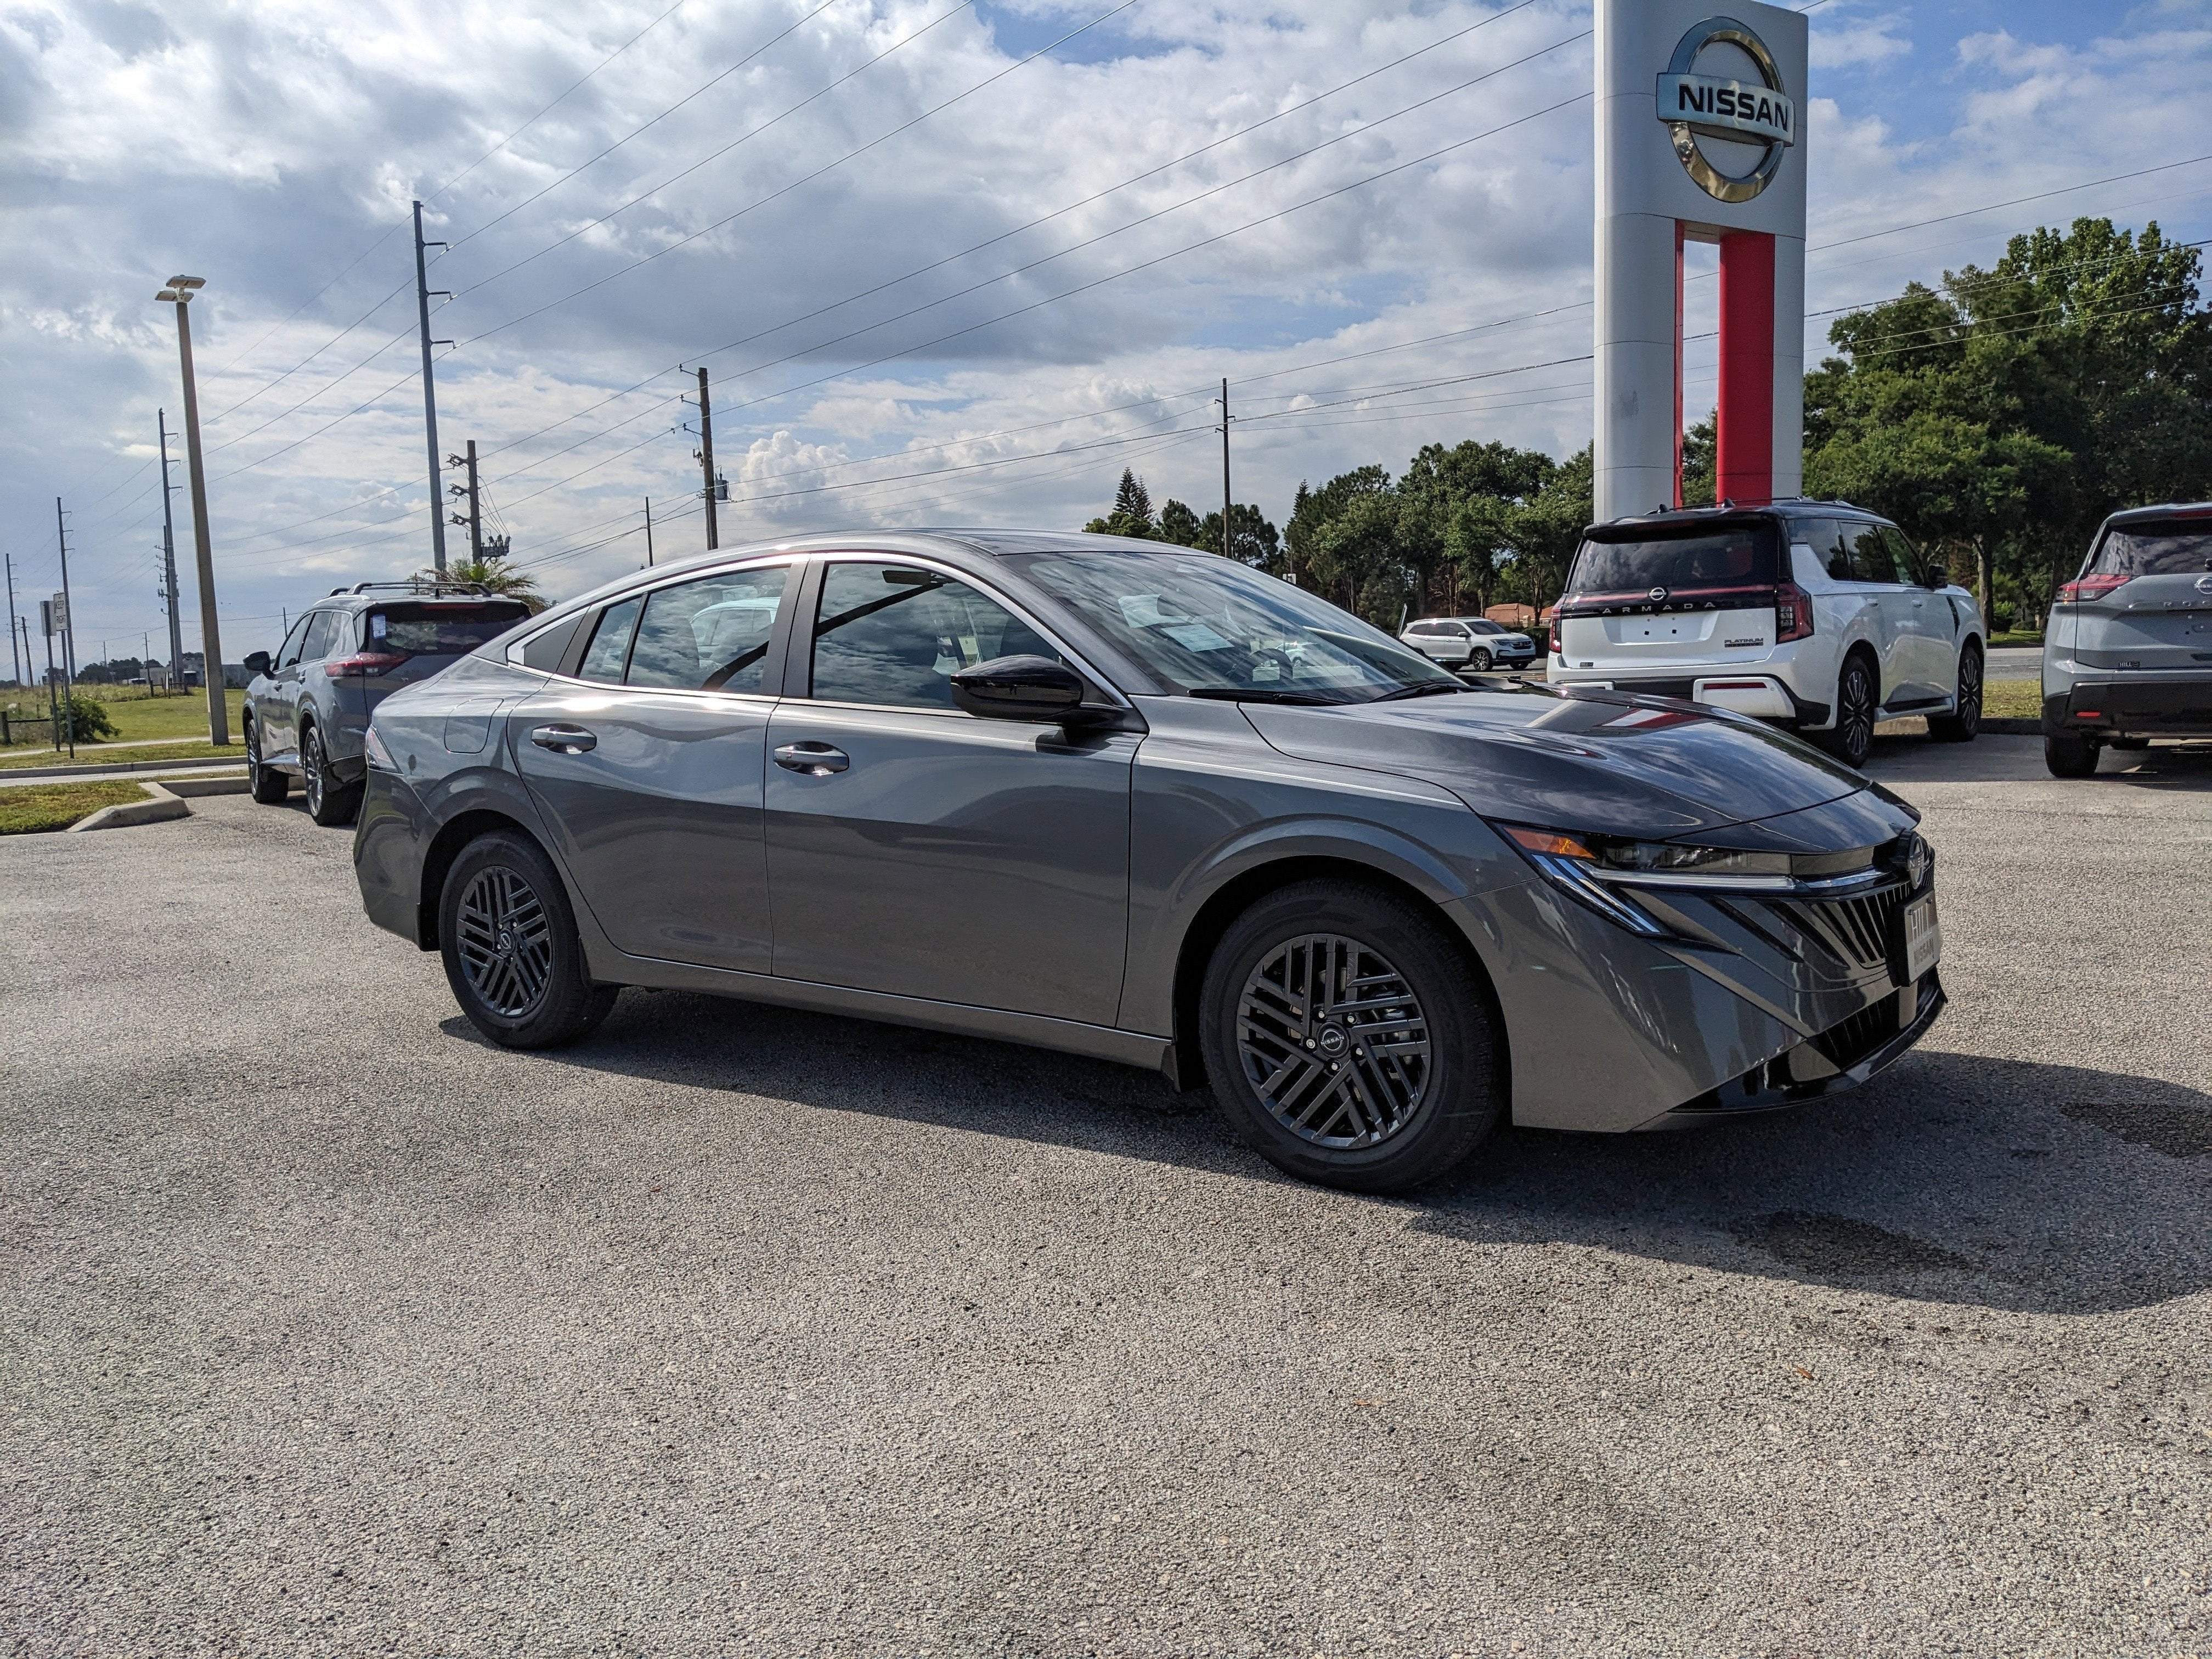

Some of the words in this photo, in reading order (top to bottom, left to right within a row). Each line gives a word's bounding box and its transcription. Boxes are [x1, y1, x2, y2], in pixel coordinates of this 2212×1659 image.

[1679, 84, 1788, 132] NISSAN
[1602, 602, 1716, 614] ARMADA
[1911, 902, 1932, 947] HILL
[1321, 1035, 1344, 1046] NISSAN
